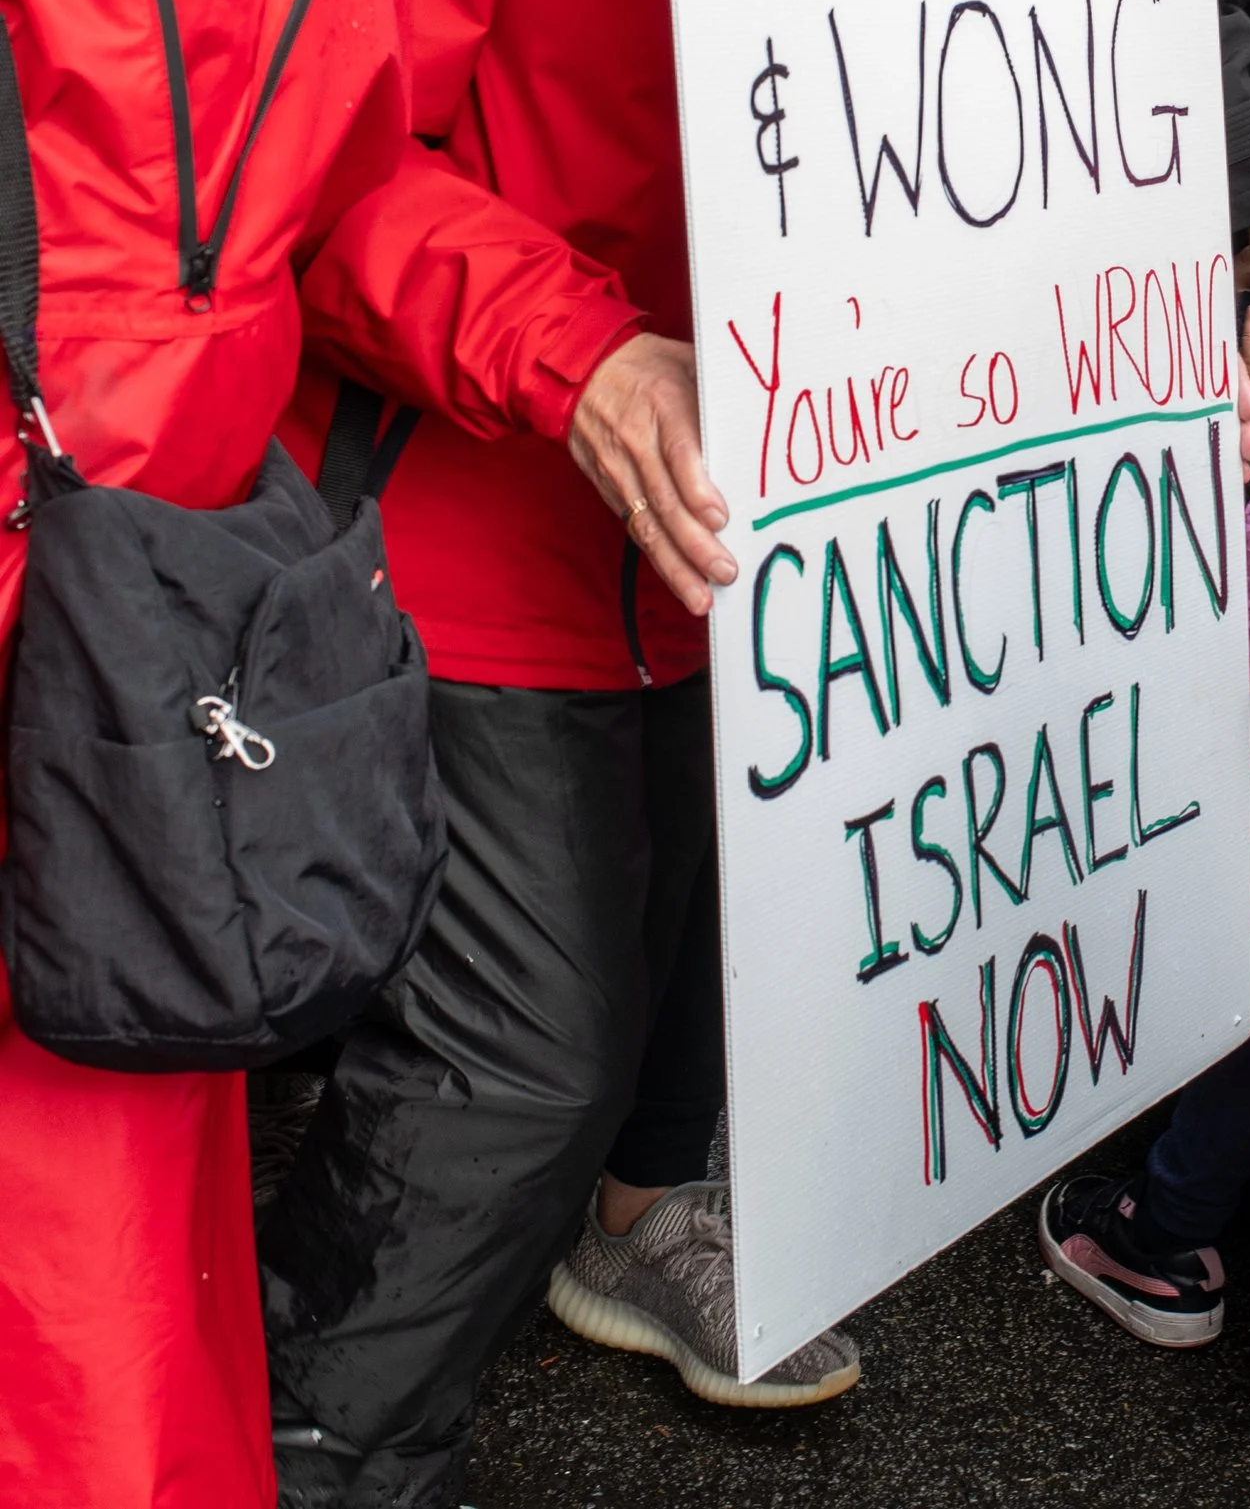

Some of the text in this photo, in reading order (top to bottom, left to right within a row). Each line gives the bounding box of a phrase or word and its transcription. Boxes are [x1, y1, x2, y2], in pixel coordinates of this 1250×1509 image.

[750, 36, 800, 238] &
[727, 254, 1231, 498] You're so WRONG
[747, 417, 1230, 801] SANCTION
[844, 681, 1201, 984] ISRAEL
[918, 888, 1148, 1187] NOW
